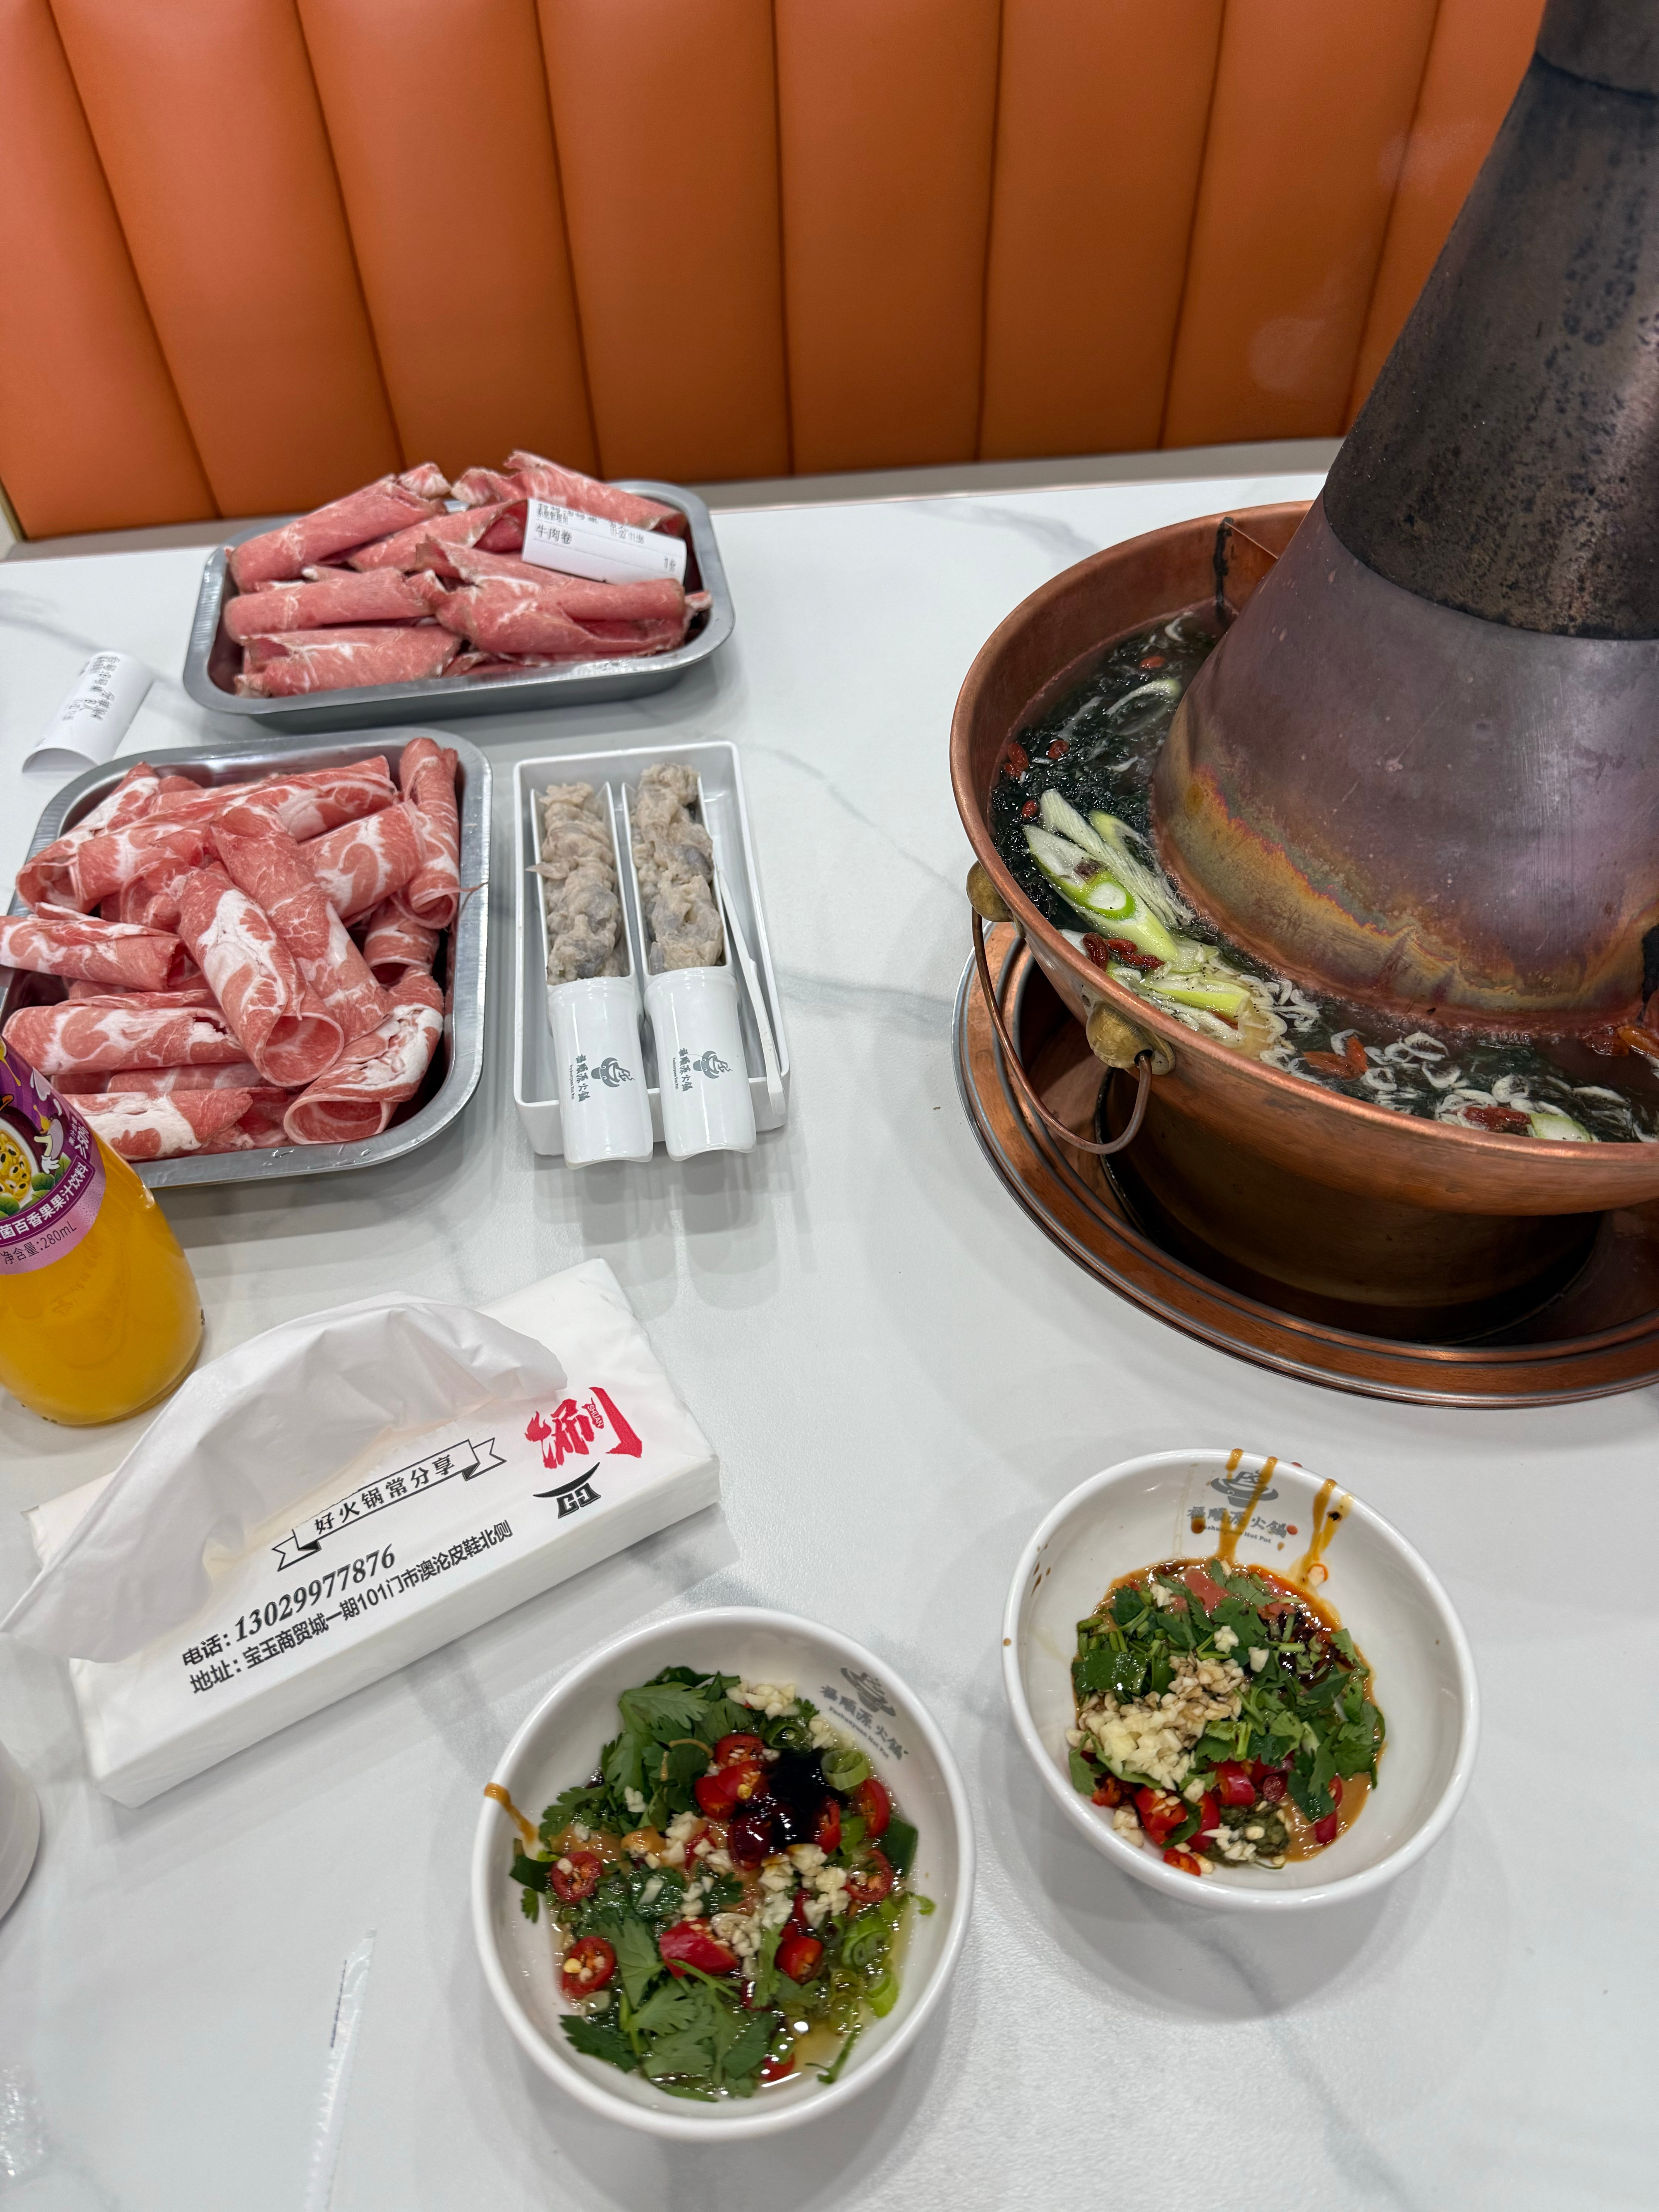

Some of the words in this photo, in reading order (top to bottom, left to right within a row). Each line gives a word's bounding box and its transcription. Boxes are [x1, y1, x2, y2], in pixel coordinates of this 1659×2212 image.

[536, 523, 573, 545] 牛肉卷
[0, 1162, 88, 1240] 菌百香果果汁饮料
[587, 1404, 604, 1427] SHUAN
[314, 1454, 455, 1535] 好火锅常分享
[1244, 1531, 1257, 1540] Hot
[1259, 1535, 1271, 1544] Pot
